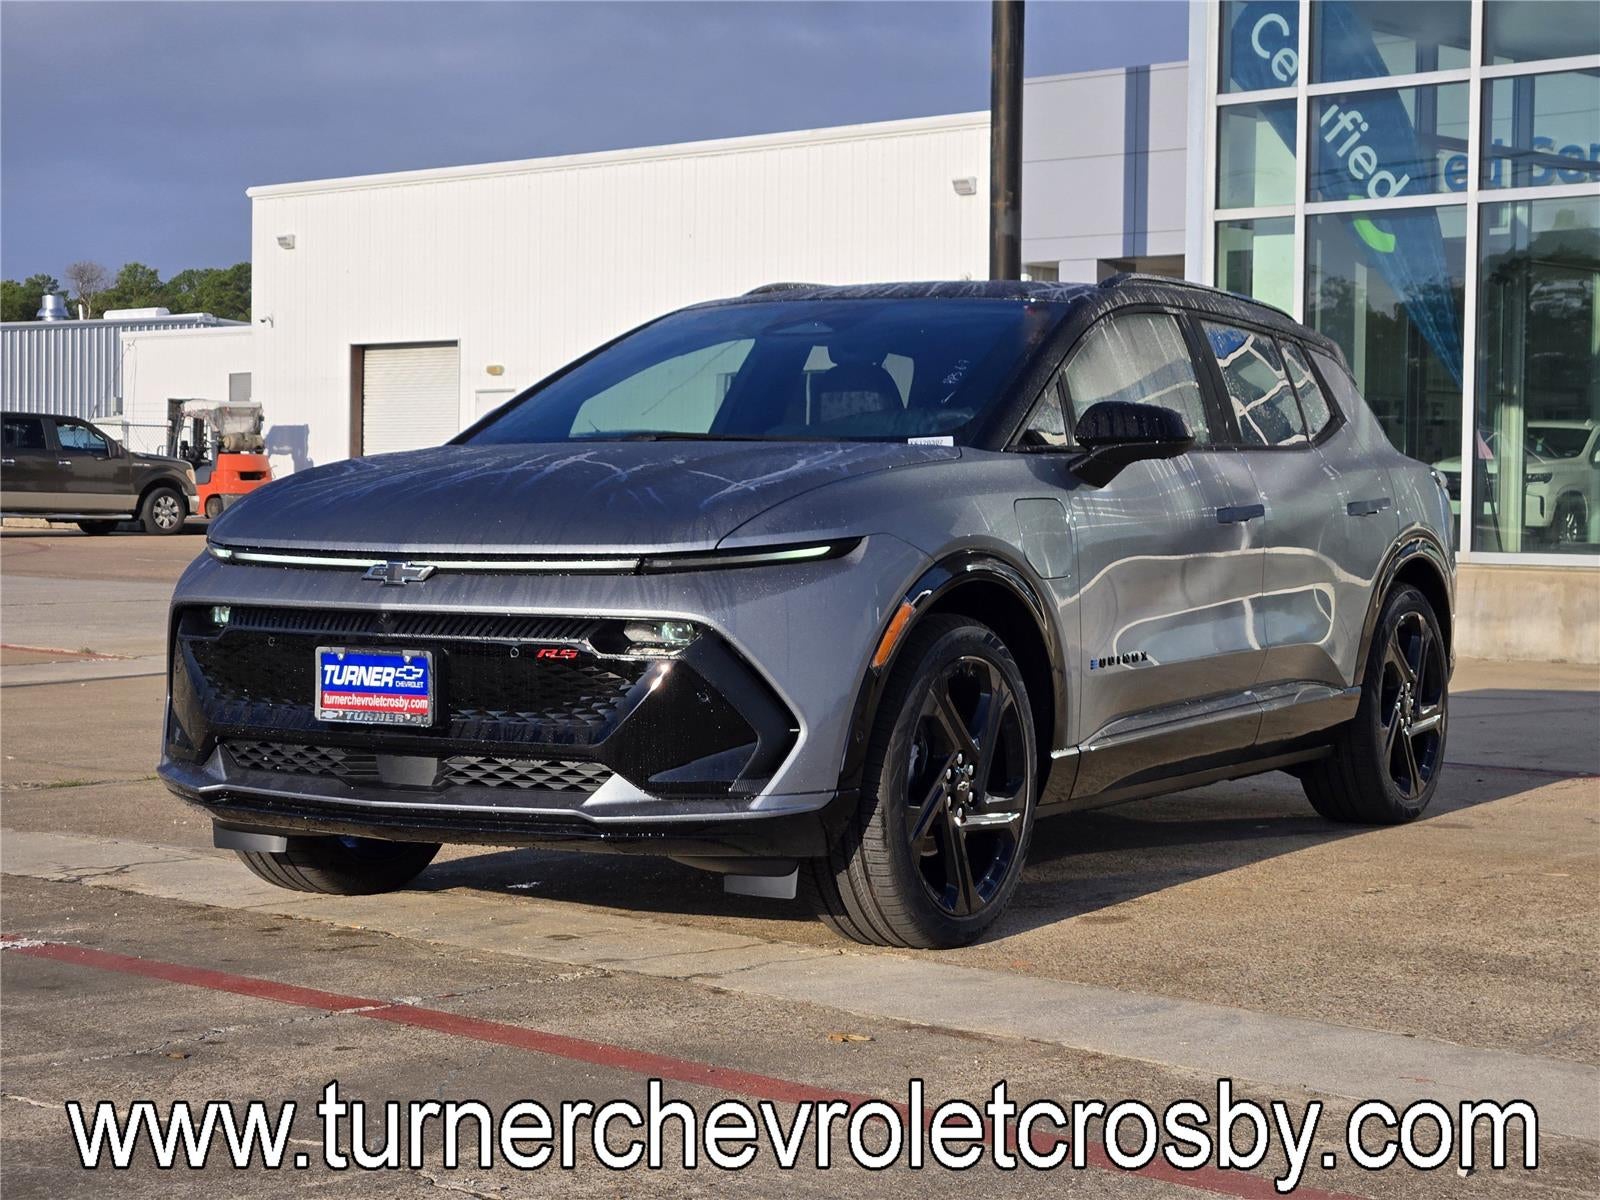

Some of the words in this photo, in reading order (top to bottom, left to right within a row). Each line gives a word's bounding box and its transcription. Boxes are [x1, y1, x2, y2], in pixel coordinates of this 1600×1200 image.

[1251, 13, 1410, 199] Ceified
[537, 648, 578, 659] RS
[324, 664, 396, 688] TURNER
[395, 680, 424, 689] CHEVROLET
[324, 693, 428, 711] turnerchevroletcrosby.com
[344, 711, 406, 723] TURNER
